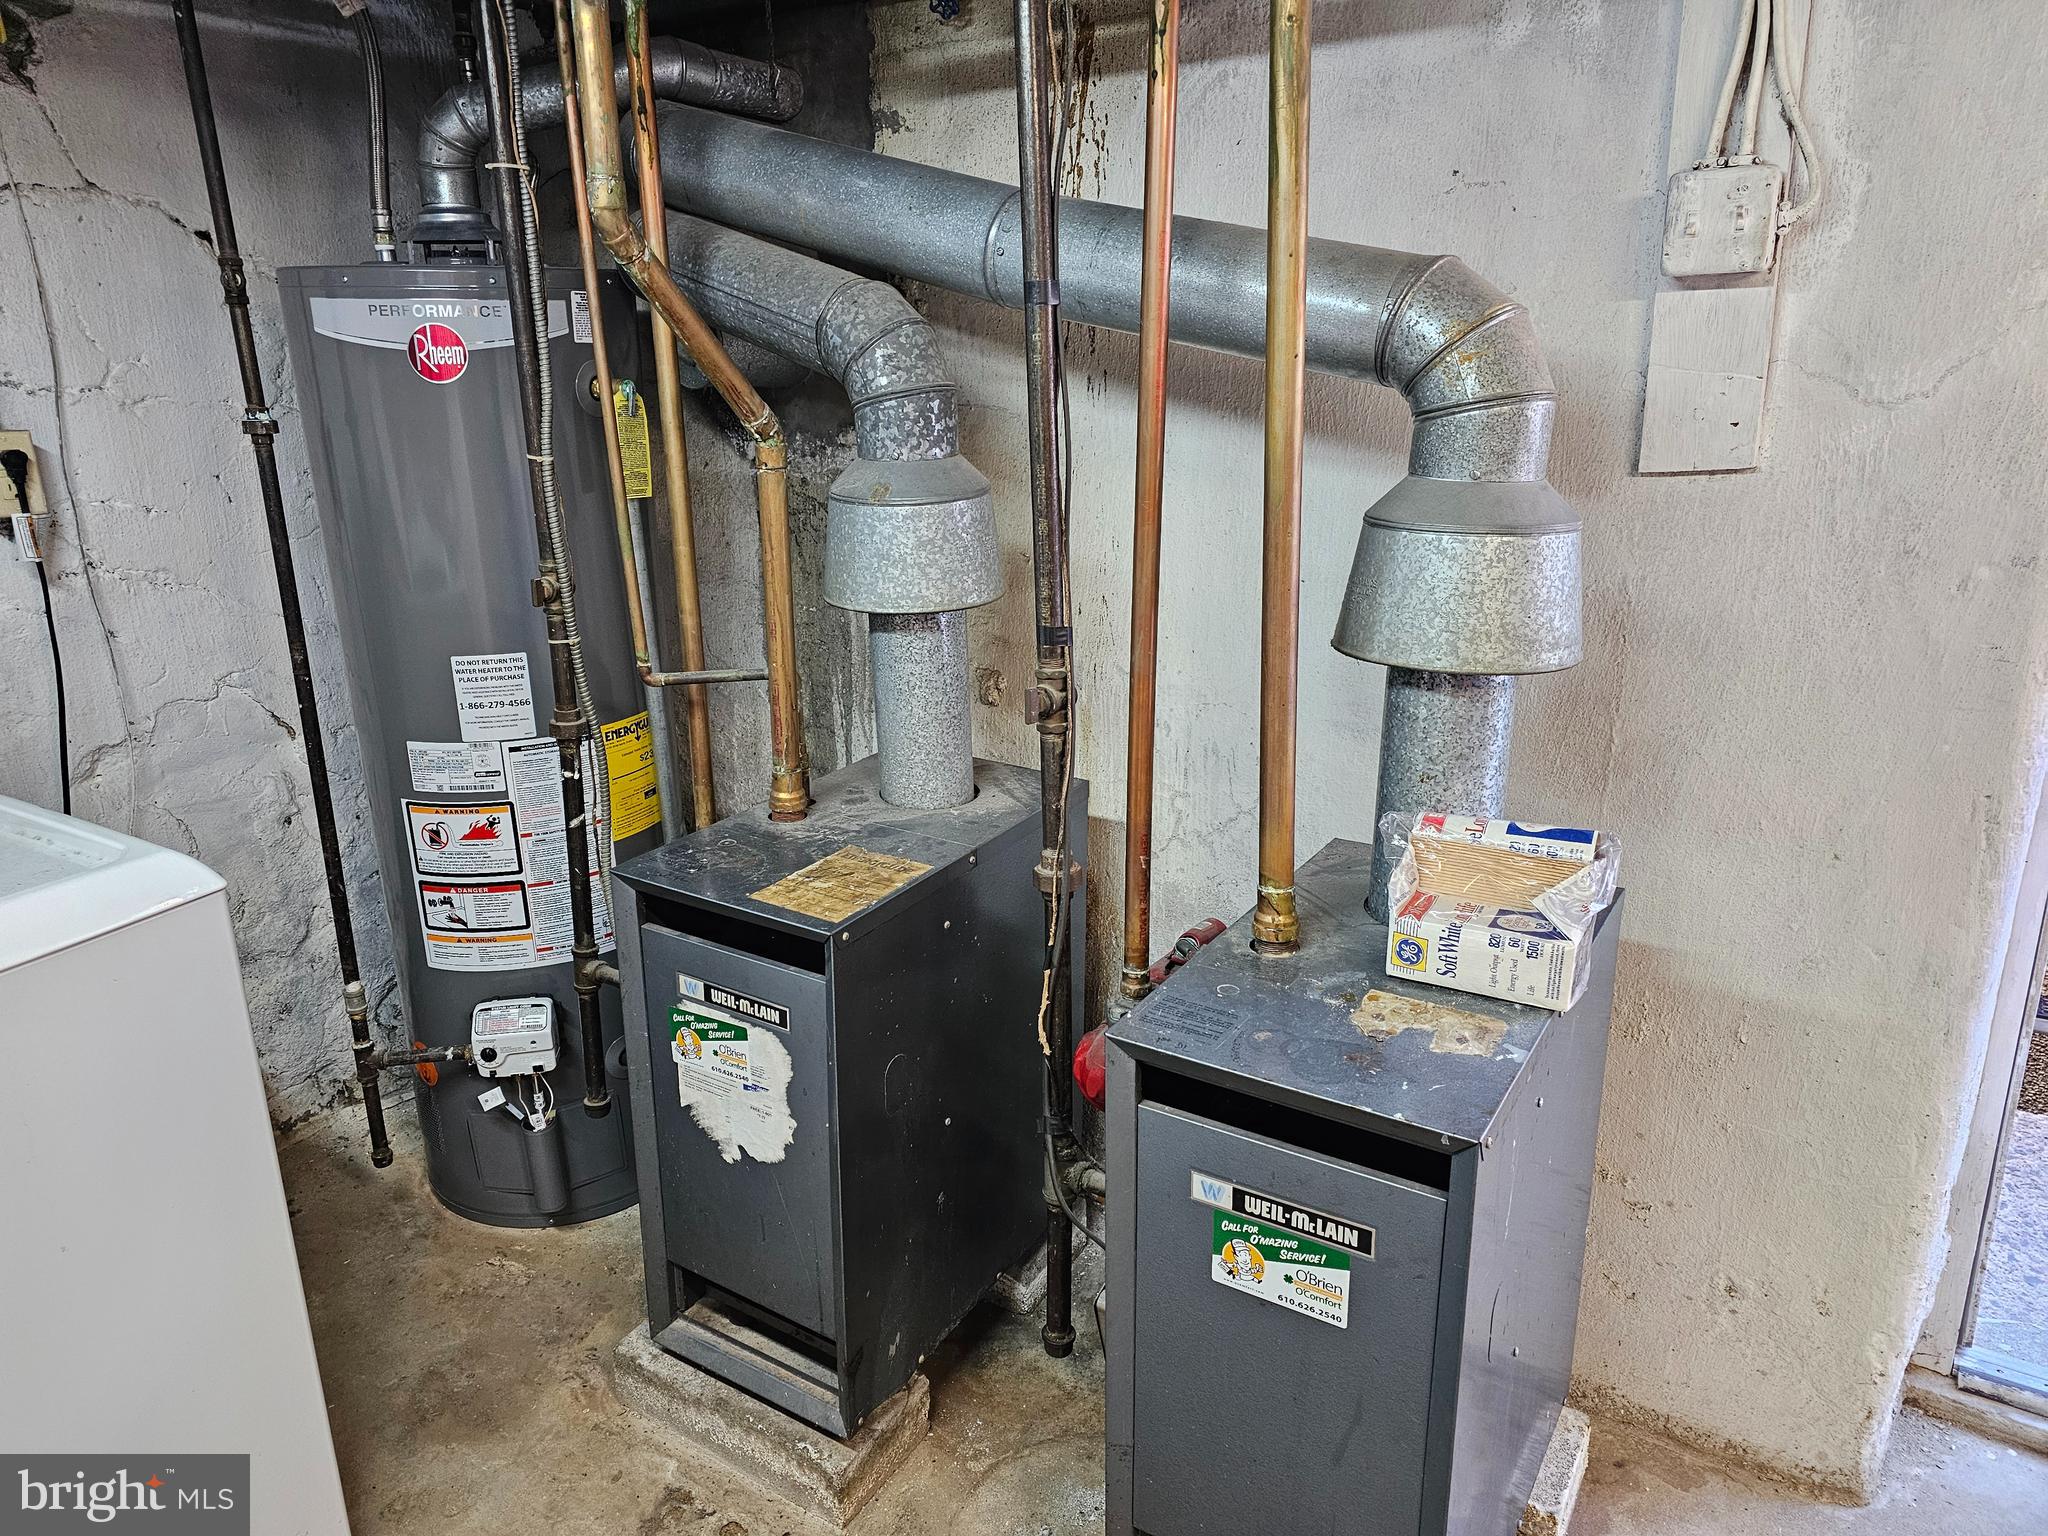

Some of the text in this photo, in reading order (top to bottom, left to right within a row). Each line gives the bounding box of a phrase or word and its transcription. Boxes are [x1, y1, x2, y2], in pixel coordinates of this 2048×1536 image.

[414, 324, 465, 373] Rheem
[481, 657, 508, 666] RETURN
[490, 673, 525, 682] PURCHASE
[459, 698, 531, 710] 1-866-279-4566
[605, 717, 649, 742] ENERGYGU
[1438, 922, 1463, 953] White
[1488, 933, 1502, 949] 820
[1508, 937, 1521, 949] 60
[1526, 940, 1540, 960] 1500
[1435, 953, 1459, 979] Soft
[1507, 958, 1519, 992] Energy Used
[1526, 984, 1536, 996] Life
[673, 1014, 695, 1022] CALL FOR
[690, 1022, 718, 1030] O'MAZING
[708, 1030, 734, 1039] SERVICE!
[719, 1044, 747, 1060] O'Brien
[720, 1058, 748, 1072] O'Comfort
[711, 1065, 750, 1082] 610.626.2540
[1221, 1220, 1259, 1234] CALL FOR
[1250, 1234, 1298, 1249] O'MAZING
[1279, 1249, 1327, 1264] SERVICE!
[1296, 1269, 1343, 1295] O'Brien
[1295, 1287, 1343, 1311] O'Comfort
[1277, 1294, 1342, 1323] 610.626.2540
